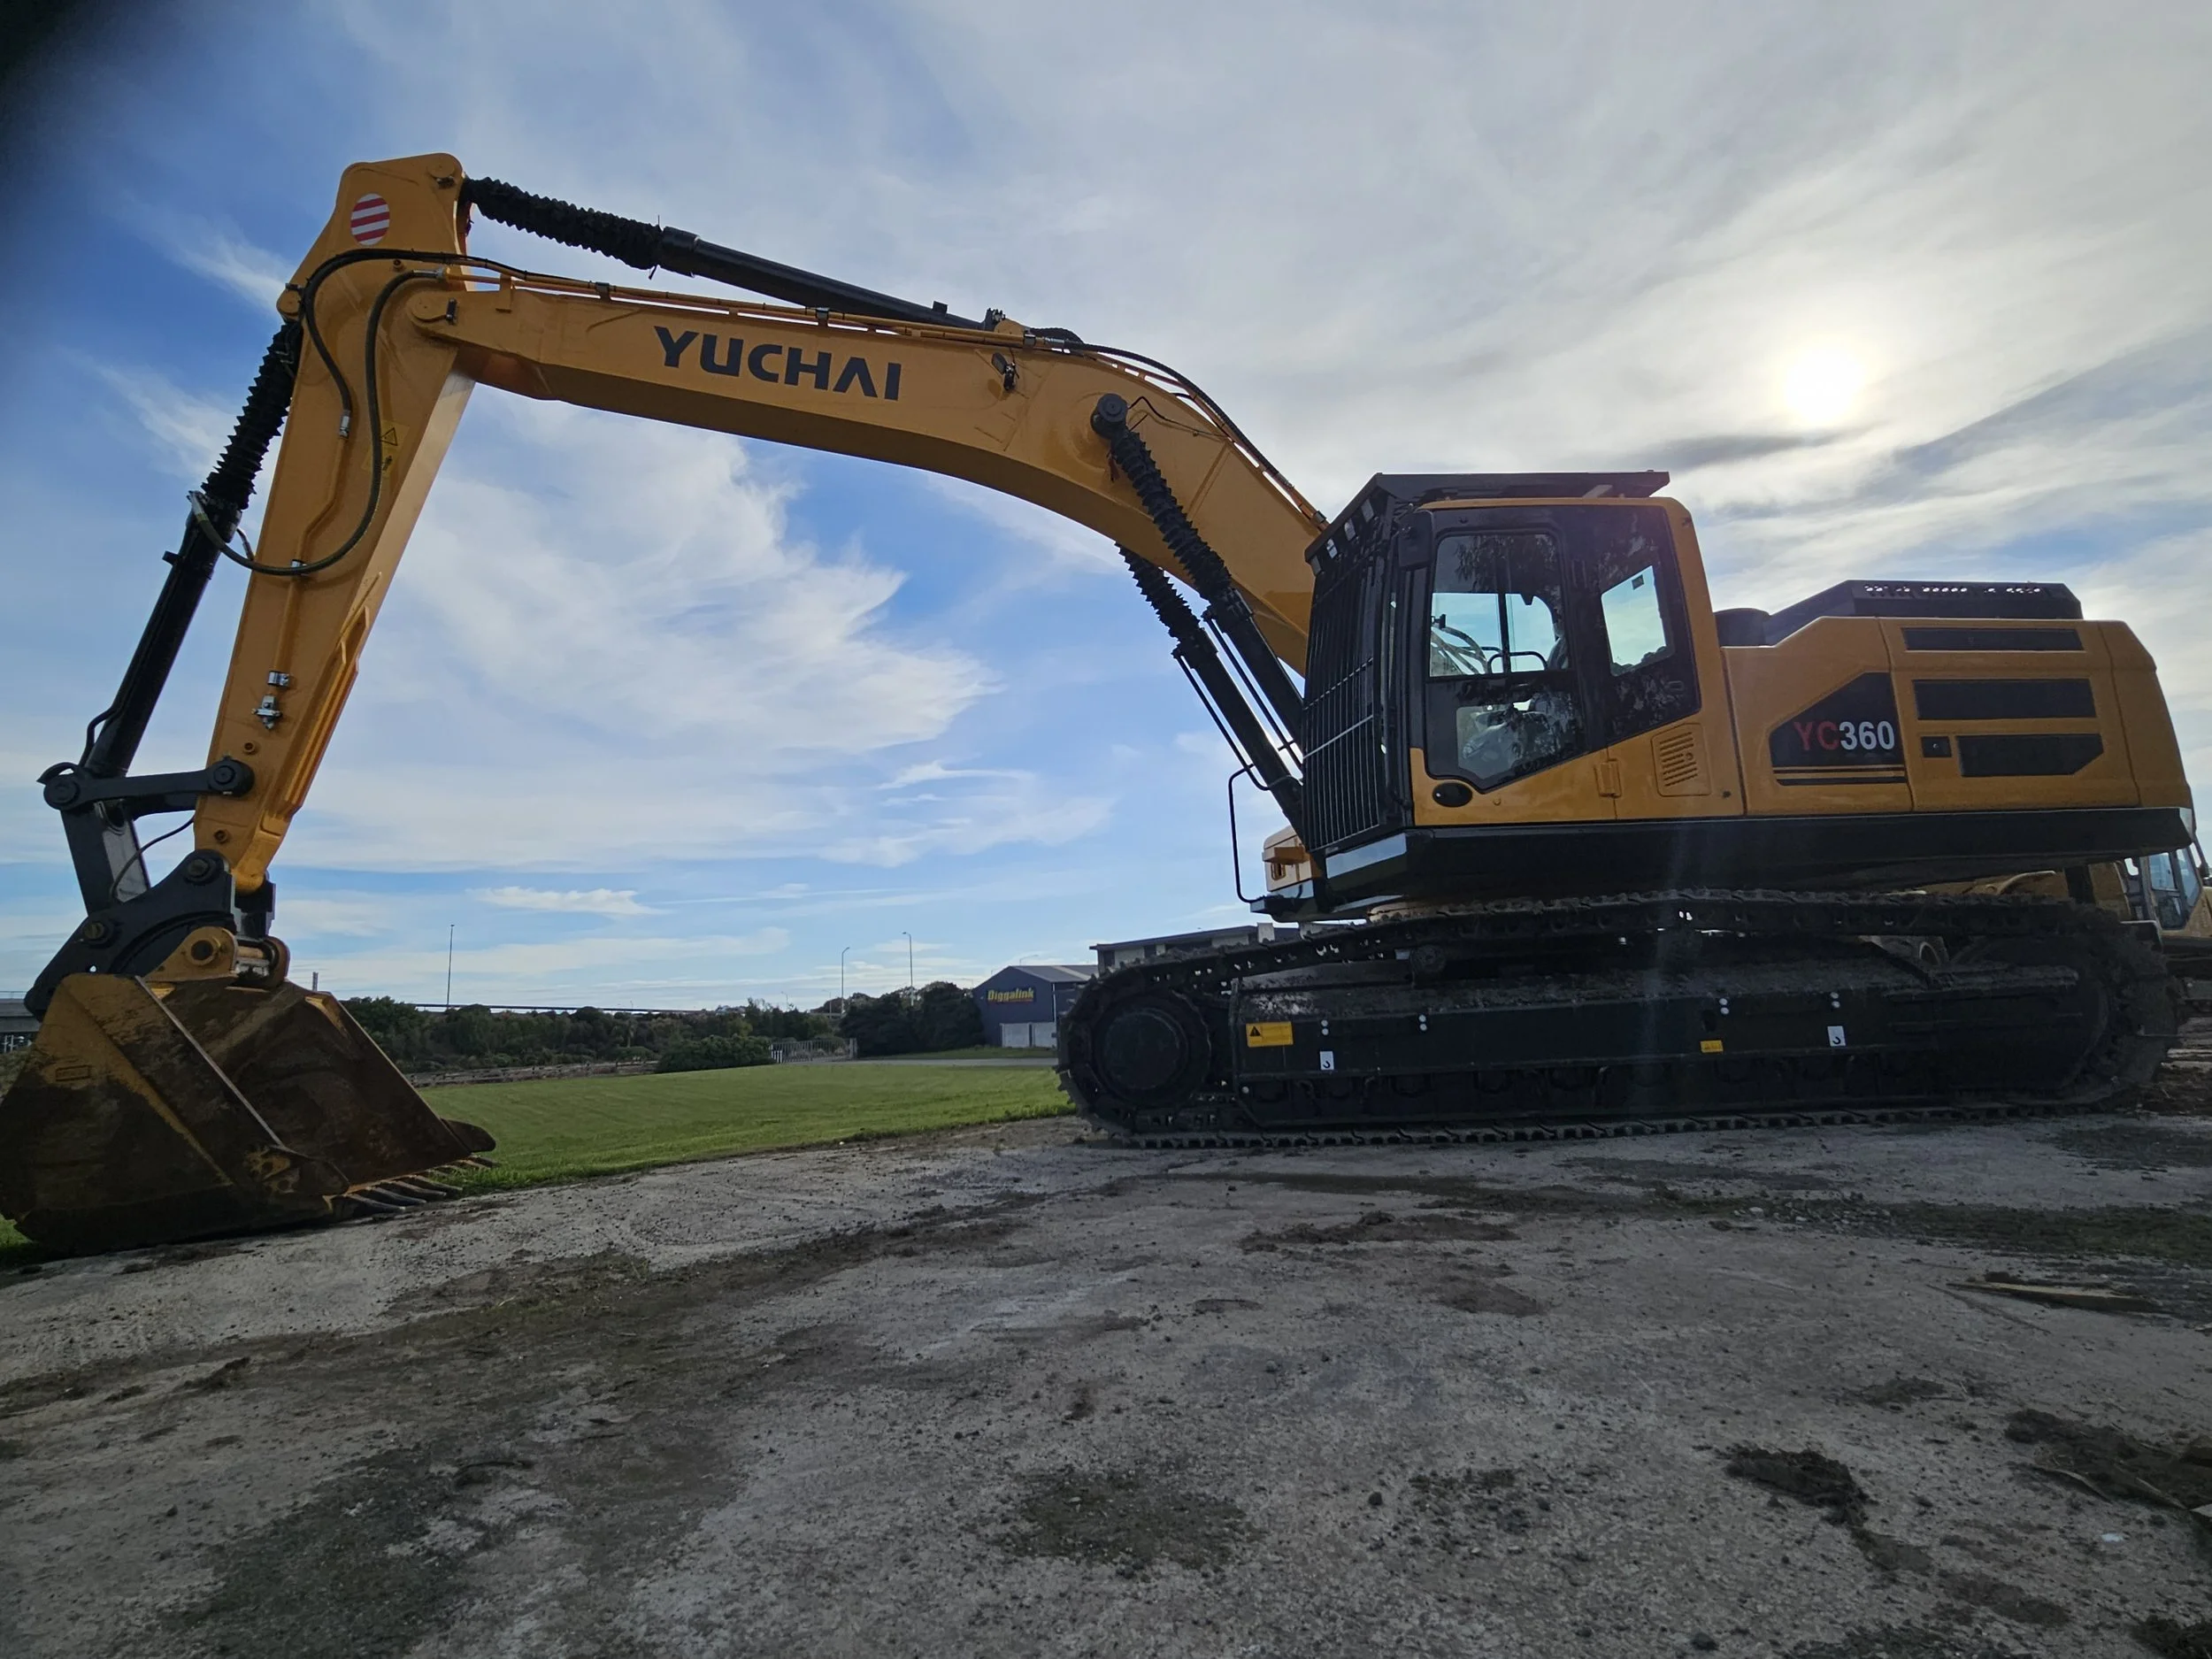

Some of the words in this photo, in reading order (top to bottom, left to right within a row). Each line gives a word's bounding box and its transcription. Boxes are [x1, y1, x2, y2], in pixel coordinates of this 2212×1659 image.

[654, 326, 902, 401] YUCHAI
[1793, 720, 1895, 750] YC360
[987, 987, 1034, 1002] Diggalink
